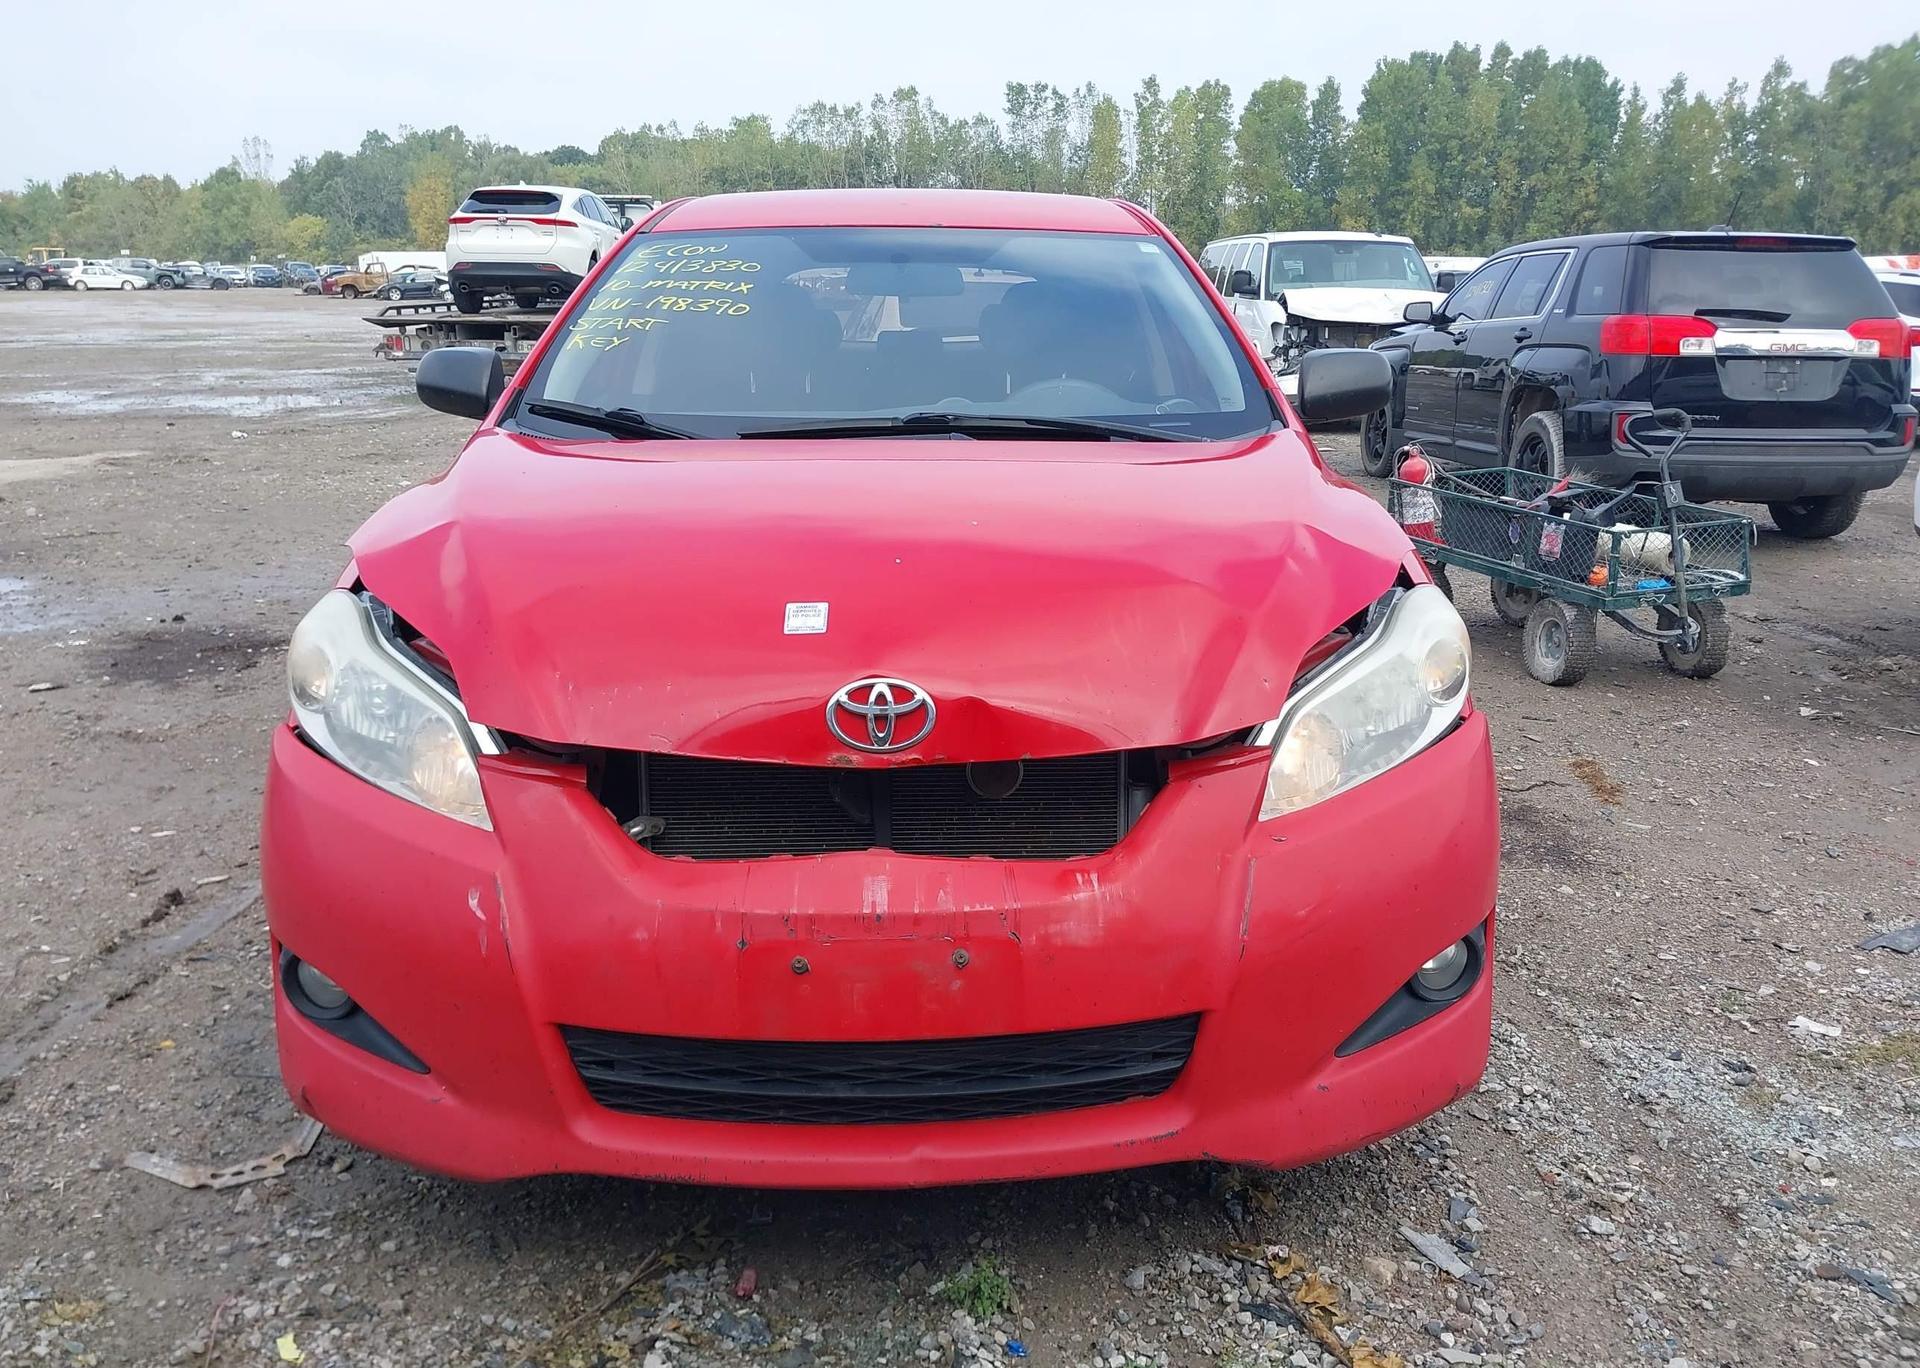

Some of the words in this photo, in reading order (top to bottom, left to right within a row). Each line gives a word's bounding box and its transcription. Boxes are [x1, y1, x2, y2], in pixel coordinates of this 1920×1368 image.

[639, 244, 729, 258] ECON
[569, 318, 669, 331] START
[567, 334, 630, 351] KEY
[1769, 343, 1808, 352] GMC
